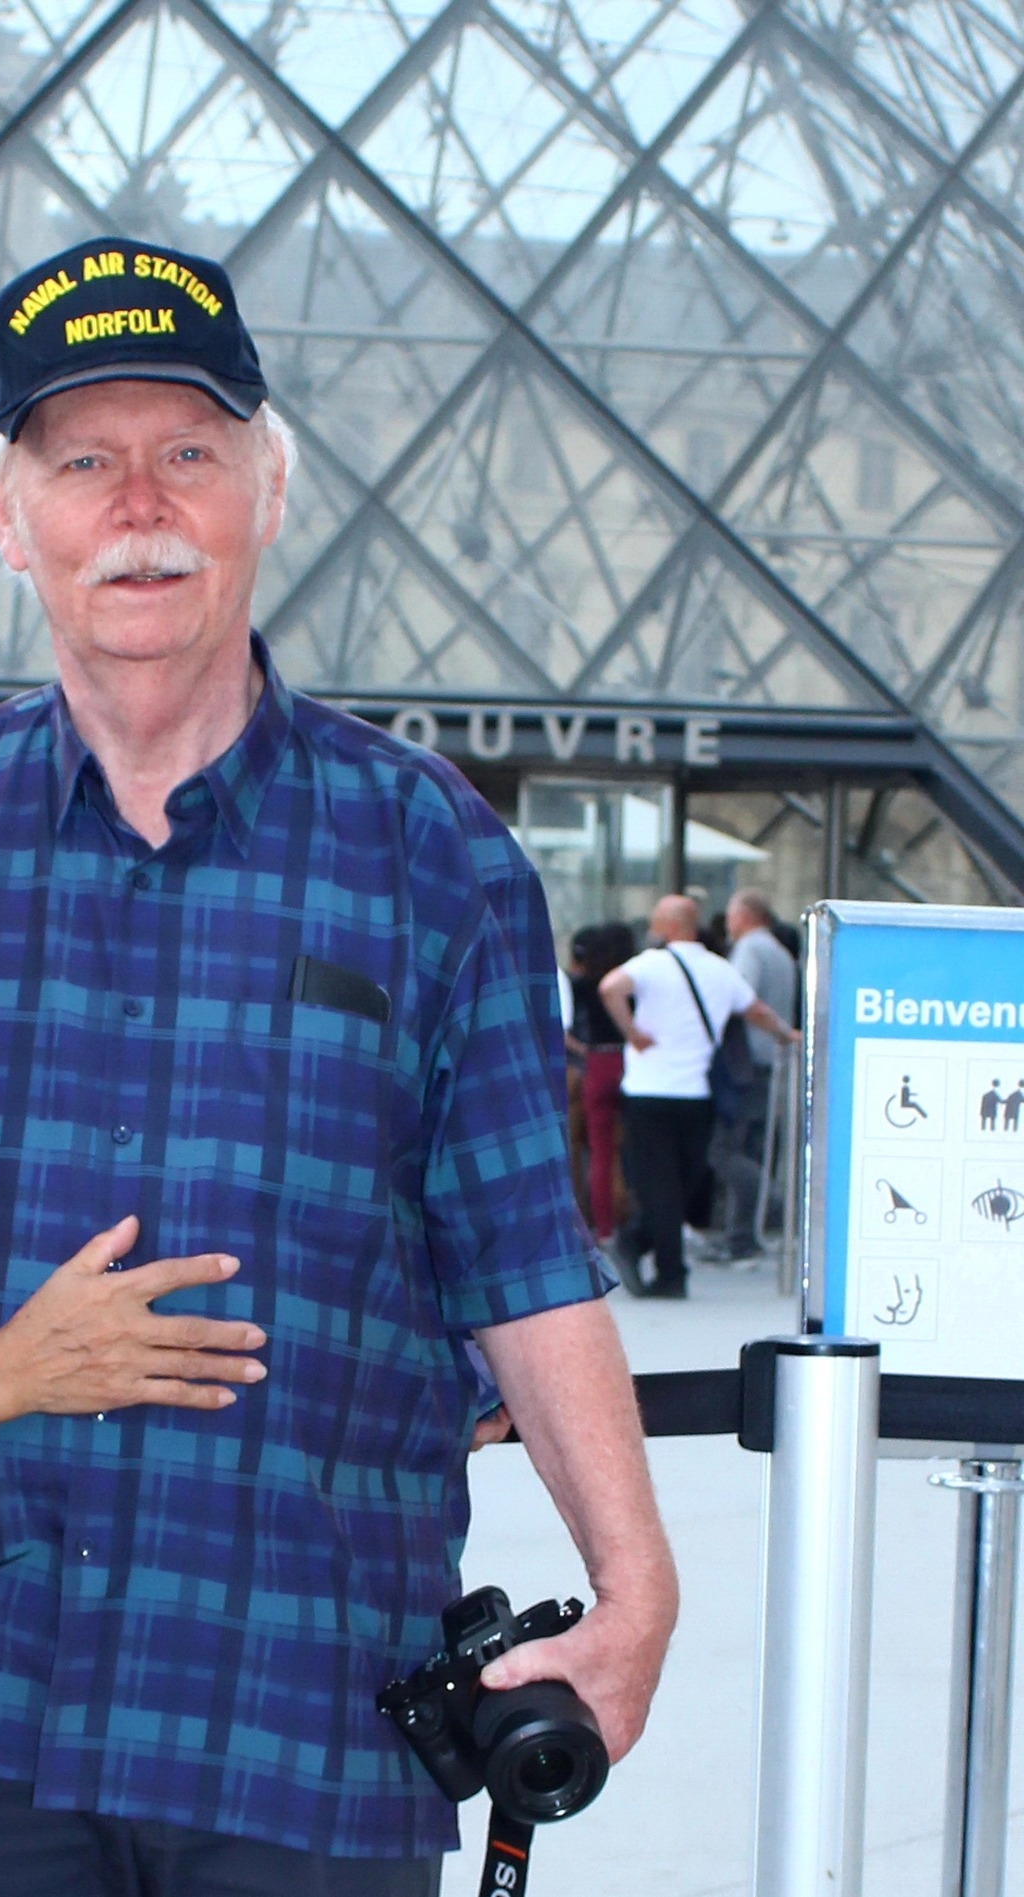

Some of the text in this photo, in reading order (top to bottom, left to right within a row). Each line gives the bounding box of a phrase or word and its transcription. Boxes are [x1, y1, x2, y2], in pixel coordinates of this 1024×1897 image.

[9, 251, 223, 335] NAVAL AIR STATION
[65, 308, 176, 345] NORFOLK
[335, 702, 722, 766] OUVRE
[855, 987, 1024, 1029] Bienven
